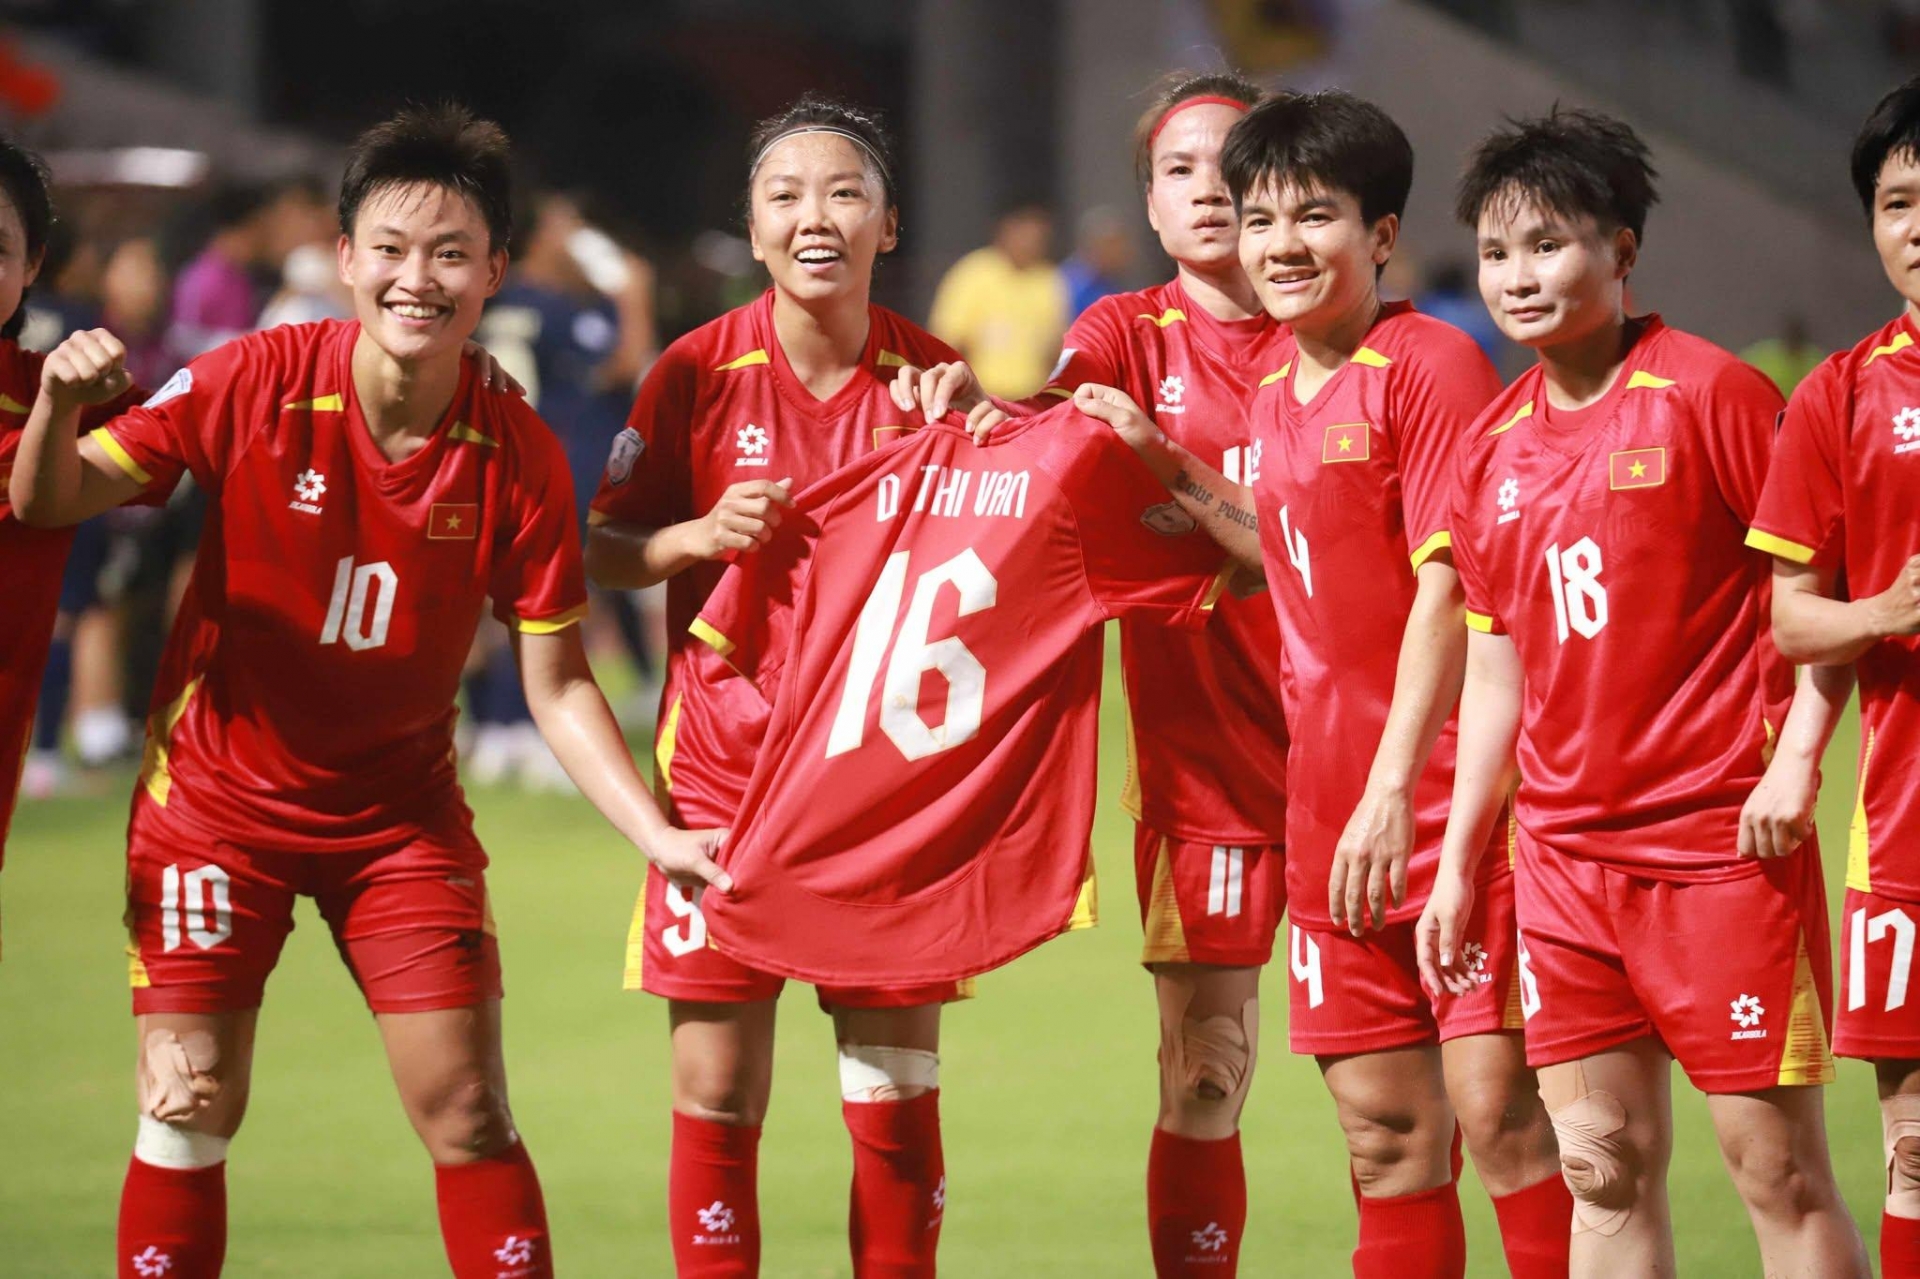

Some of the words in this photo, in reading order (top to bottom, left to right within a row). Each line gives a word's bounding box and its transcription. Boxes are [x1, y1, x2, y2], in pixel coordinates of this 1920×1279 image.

[914, 464, 972, 518] THI
[973, 470, 1030, 519] VAN
[1214, 500, 1260, 533] yours
[1279, 504, 1313, 599] 4
[1544, 535, 1608, 646] 18
[319, 554, 399, 652] 10
[825, 547, 998, 763] 16
[160, 863, 234, 954] 10
[1207, 846, 1243, 918] 11
[1291, 923, 1324, 1009] 4
[1848, 907, 1916, 1012] 17
